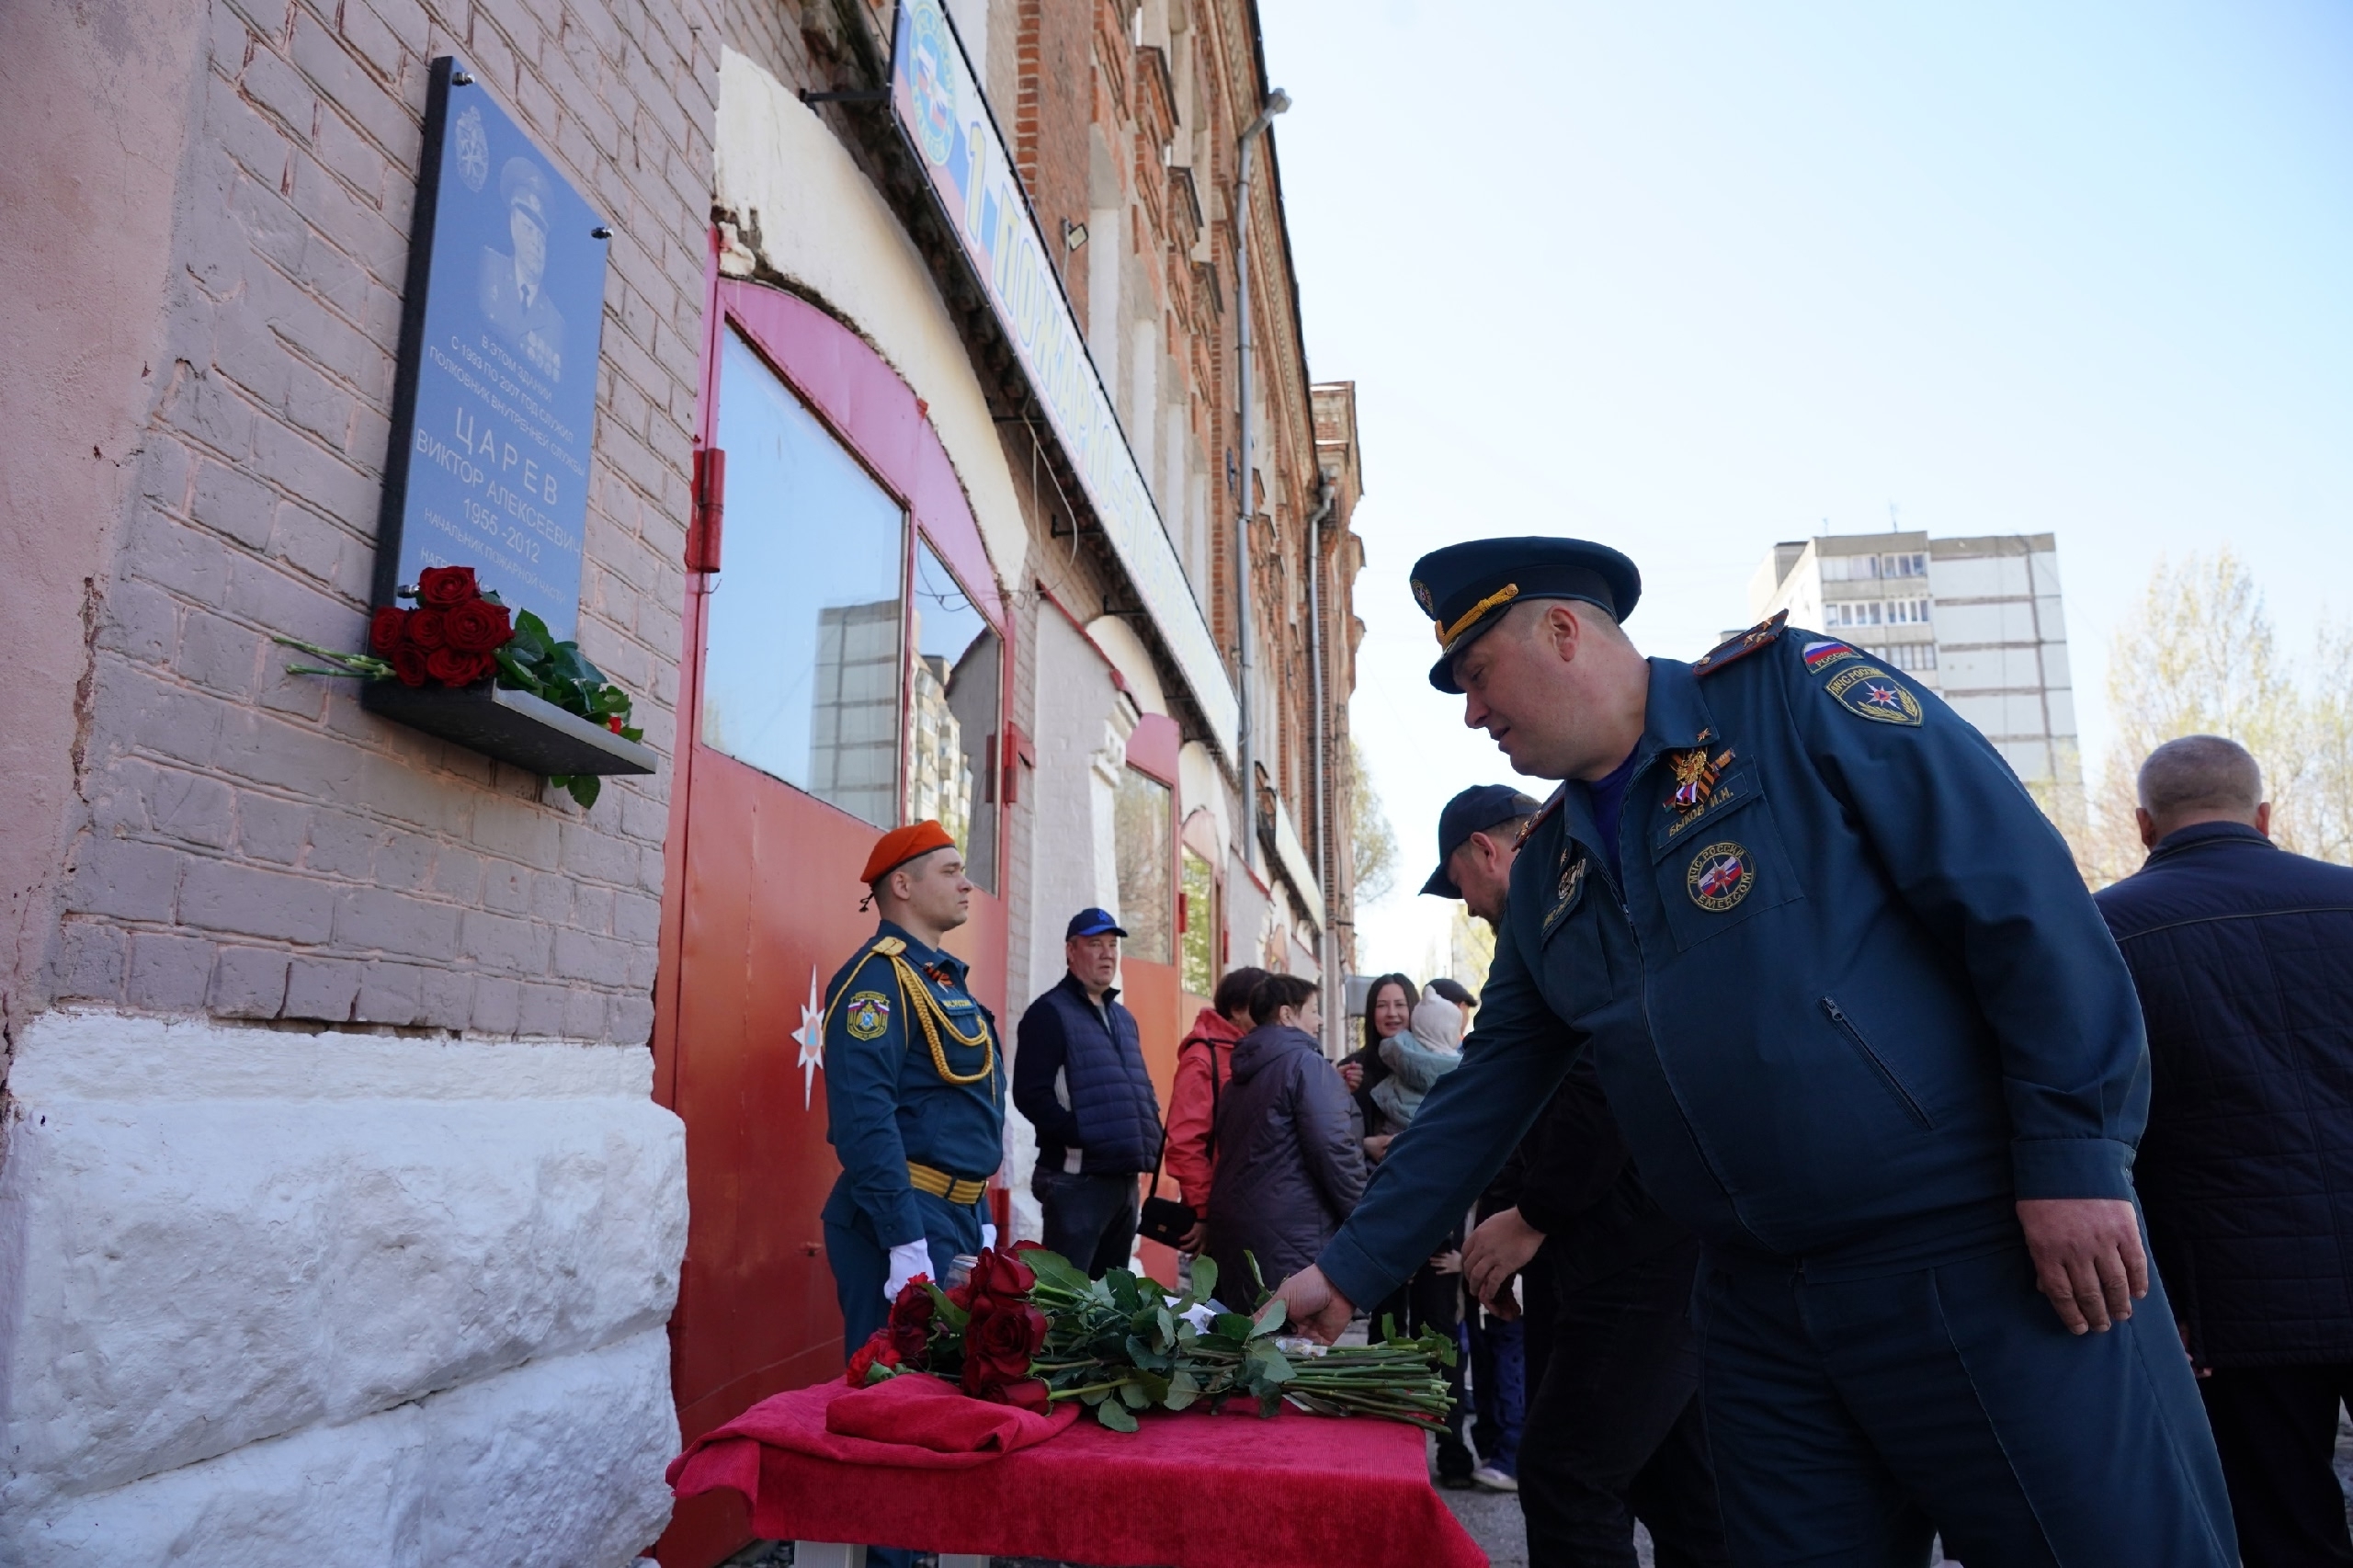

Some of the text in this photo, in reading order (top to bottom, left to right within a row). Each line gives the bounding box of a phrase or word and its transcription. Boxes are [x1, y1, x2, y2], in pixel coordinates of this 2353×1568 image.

[965, 120, 986, 244] 1
[451, 335, 574, 445] С 1993 ПО 2007 ГОД СЛУЖИЛ
[482, 335, 552, 403] В ЭТОМ ЗДАНИИ
[429, 346, 585, 477] ПОЛКОВНИК ВНУТРЕННЕЙ СЛУЖБЫ
[416, 428, 582, 559] ВИКТОР АЛЕКСЕЕВИЧ
[456, 406, 558, 506] ЦАРЕВ
[424, 506, 566, 606] НАЧАЛЬНИК ПОЖАРНОЙ ЧАСТИ
[463, 498, 499, 537] 1955
[1830, 668, 1886, 695] МЧС РОССИИ
[1669, 804, 1705, 837] БЫКОВ
[1689, 845, 1745, 884] МЧС РОССИИ
[1698, 872, 1752, 909] EMERCOM
